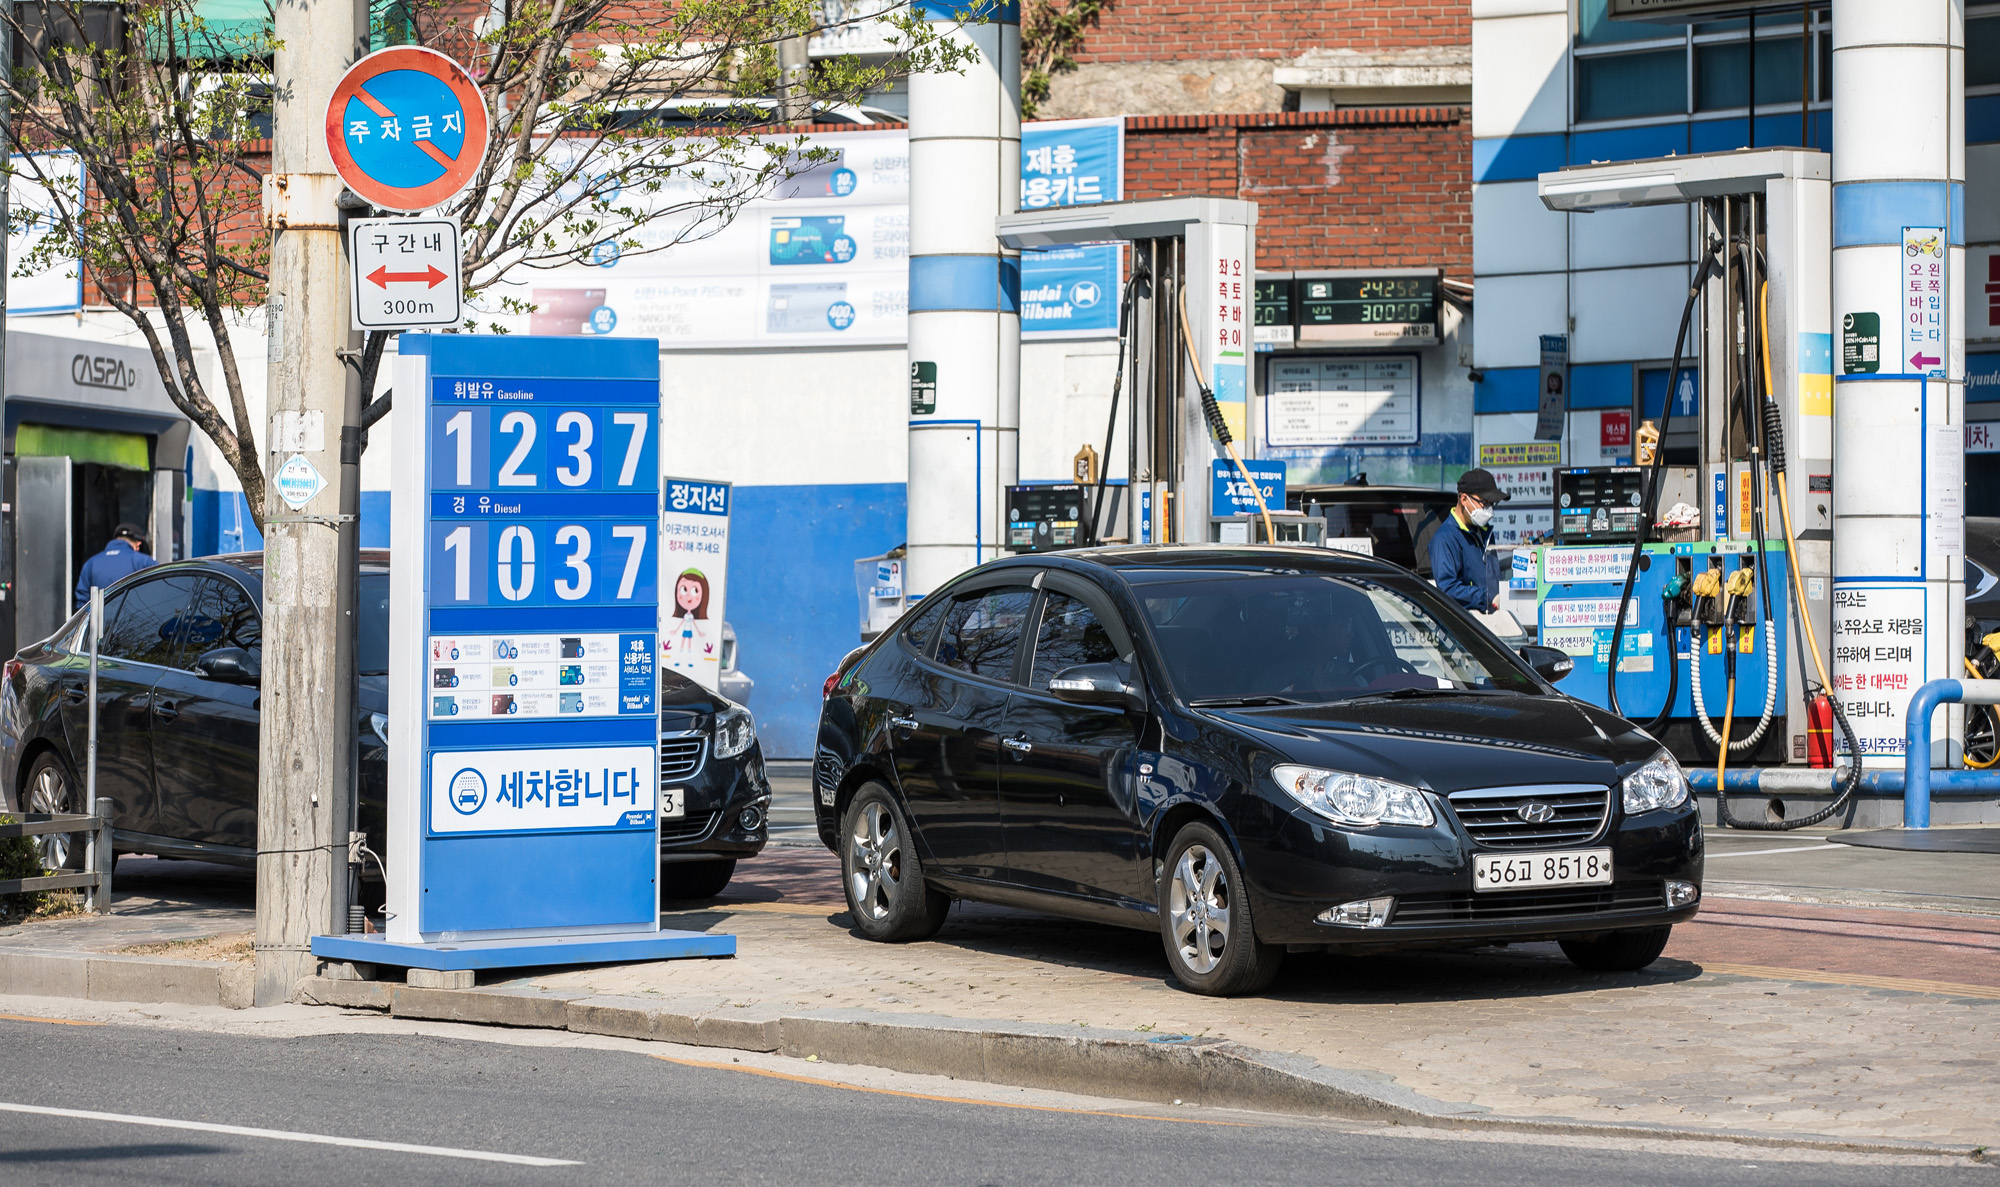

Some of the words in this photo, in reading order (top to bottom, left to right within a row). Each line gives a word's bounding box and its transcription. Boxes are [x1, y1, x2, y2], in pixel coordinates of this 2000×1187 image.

[348, 111, 462, 144] 주차금지
[1025, 144, 1078, 174] 제휴
[371, 232, 441, 254] 구간내
[1021, 285, 1064, 302] undai
[383, 300, 434, 315] 300m
[1021, 303, 1073, 319] ilbank
[1219, 259, 1228, 346] 좌측주유
[1232, 260, 1242, 346] 오토바이
[1909, 264, 1923, 342] 오토바이는
[1928, 263, 1941, 342] 왼쪽입니다
[454, 381, 494, 399] 휘발유
[497, 389, 534, 400] Gasoline
[446, 409, 648, 487] 1237
[670, 484, 725, 512] 정지선
[494, 503, 521, 514] Diesel
[665, 523, 699, 537] 이곳까지
[669, 540, 694, 552] 정지해
[695, 542, 720, 554] 주세요
[444, 524, 647, 602] 1037
[1549, 555, 1585, 564] 경유승용차는
[1588, 553, 1618, 563] 혼유방지를
[1549, 567, 1574, 576] 주유전에
[1598, 602, 1625, 612] 혼유사고
[1835, 592, 1867, 608] 주유소는
[1552, 615, 1564, 623] 손님
[1845, 619, 1883, 636] 주유소로
[1888, 618, 1923, 635] 차량을
[1837, 646, 1870, 663] 주유하여
[1874, 646, 1912, 663] 드리며
[1856, 674, 1867, 690] 한
[1871, 674, 1909, 690] 대씩만
[1847, 701, 1895, 717] 드립니다.
[1859, 738, 1907, 752] 동시주유불
[496, 767, 640, 809] 세차합니다
[663, 794, 674, 814] 3
[1543, 855, 1599, 880] 8518
